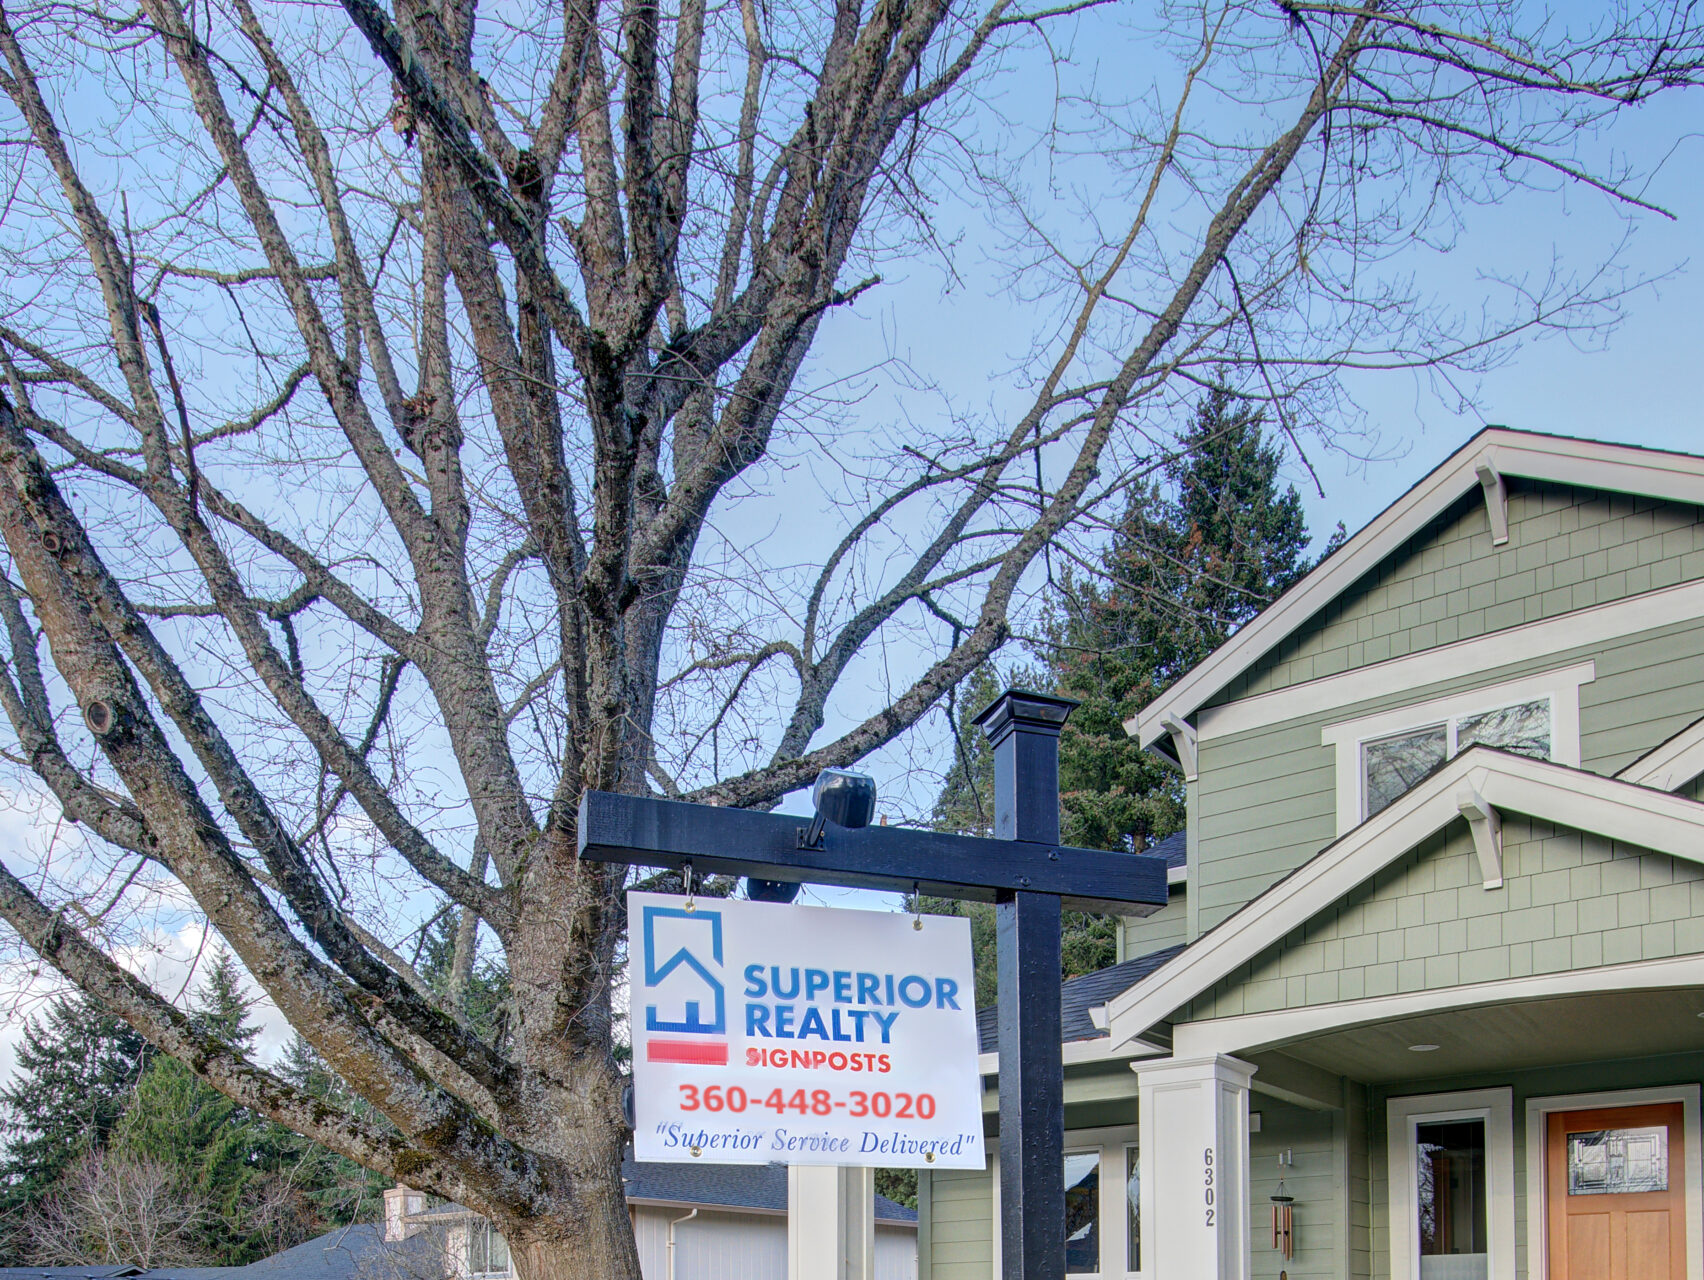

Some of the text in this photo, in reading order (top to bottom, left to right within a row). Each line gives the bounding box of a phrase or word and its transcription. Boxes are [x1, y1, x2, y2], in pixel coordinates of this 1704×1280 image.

[744, 964, 962, 1011] SUPERIOR
[745, 1003, 900, 1044] REALTY
[745, 1047, 891, 1073] SIGNPOSTS
[679, 1084, 936, 1120] 360-448-3020
[655, 1121, 975, 1156] "Superior Service Delivered"
[1204, 1147, 1215, 1227] 6302
